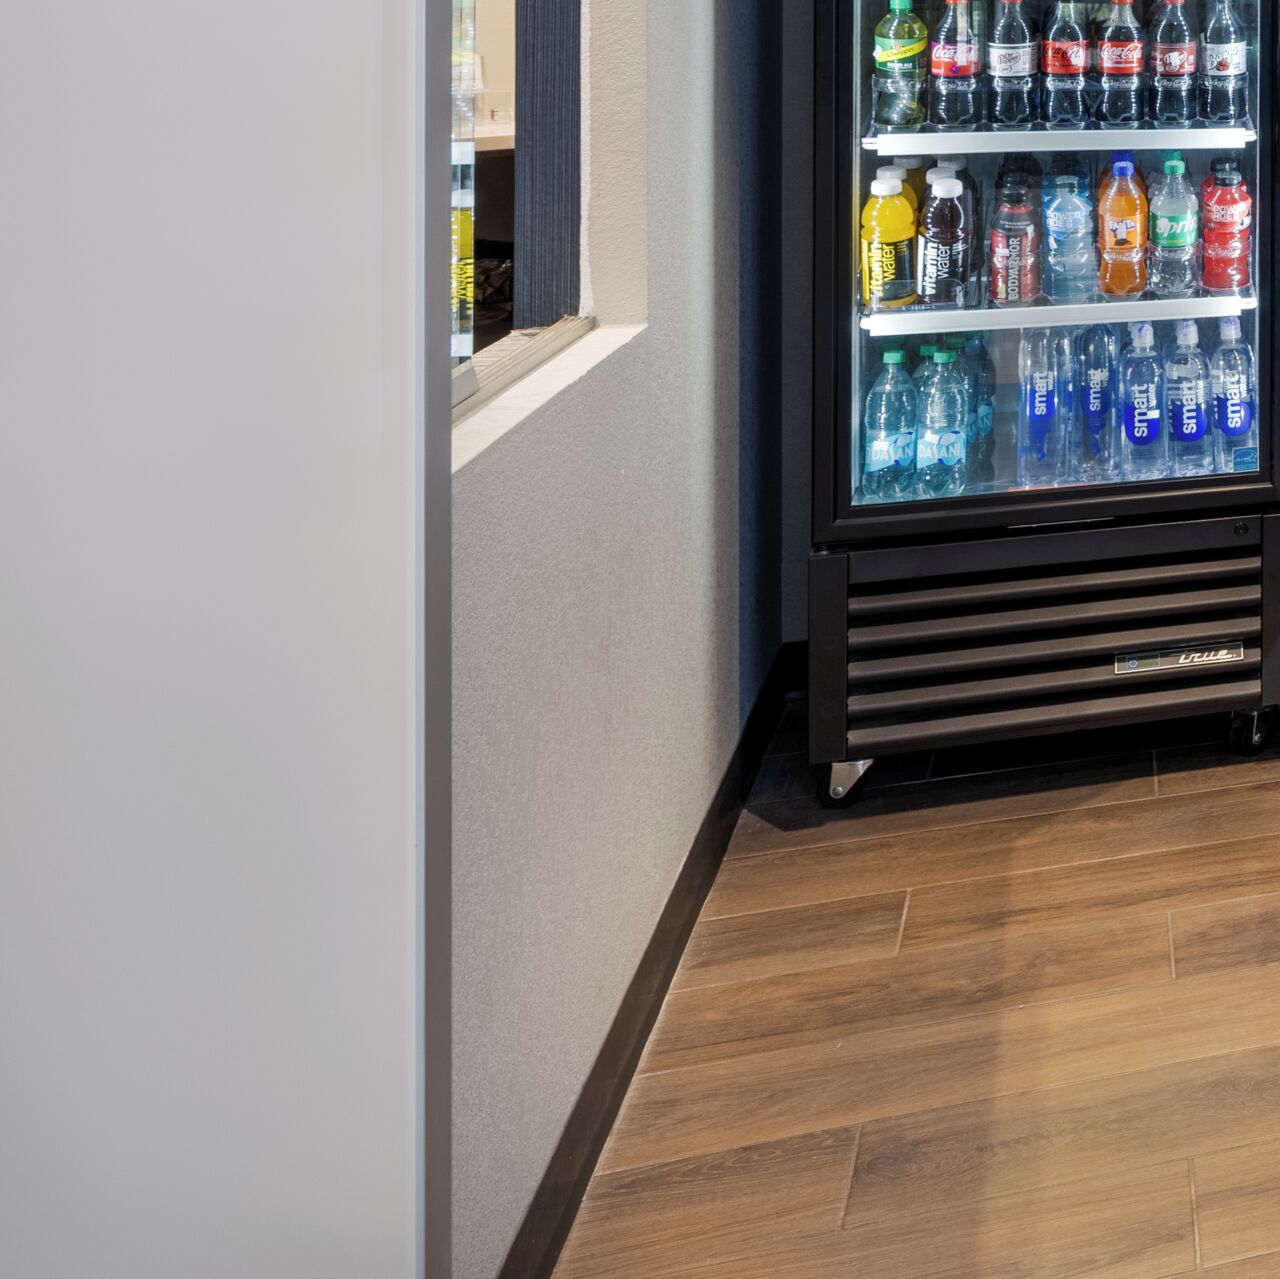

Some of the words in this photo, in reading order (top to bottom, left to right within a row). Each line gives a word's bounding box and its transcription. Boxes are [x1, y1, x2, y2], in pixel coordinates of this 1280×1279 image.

[1101, 42, 1142, 60] Coca-Cola
[883, 244, 895, 281] water
[924, 242, 938, 296] vitamin
[938, 244, 950, 279] water
[1008, 237, 1020, 301] BODYARMOR
[1034, 370, 1048, 416] smart
[1134, 383, 1148, 438] smart
[1183, 380, 1197, 434] smart
[1226, 369, 1241, 428] smart
[919, 443, 962, 461] DASANI
